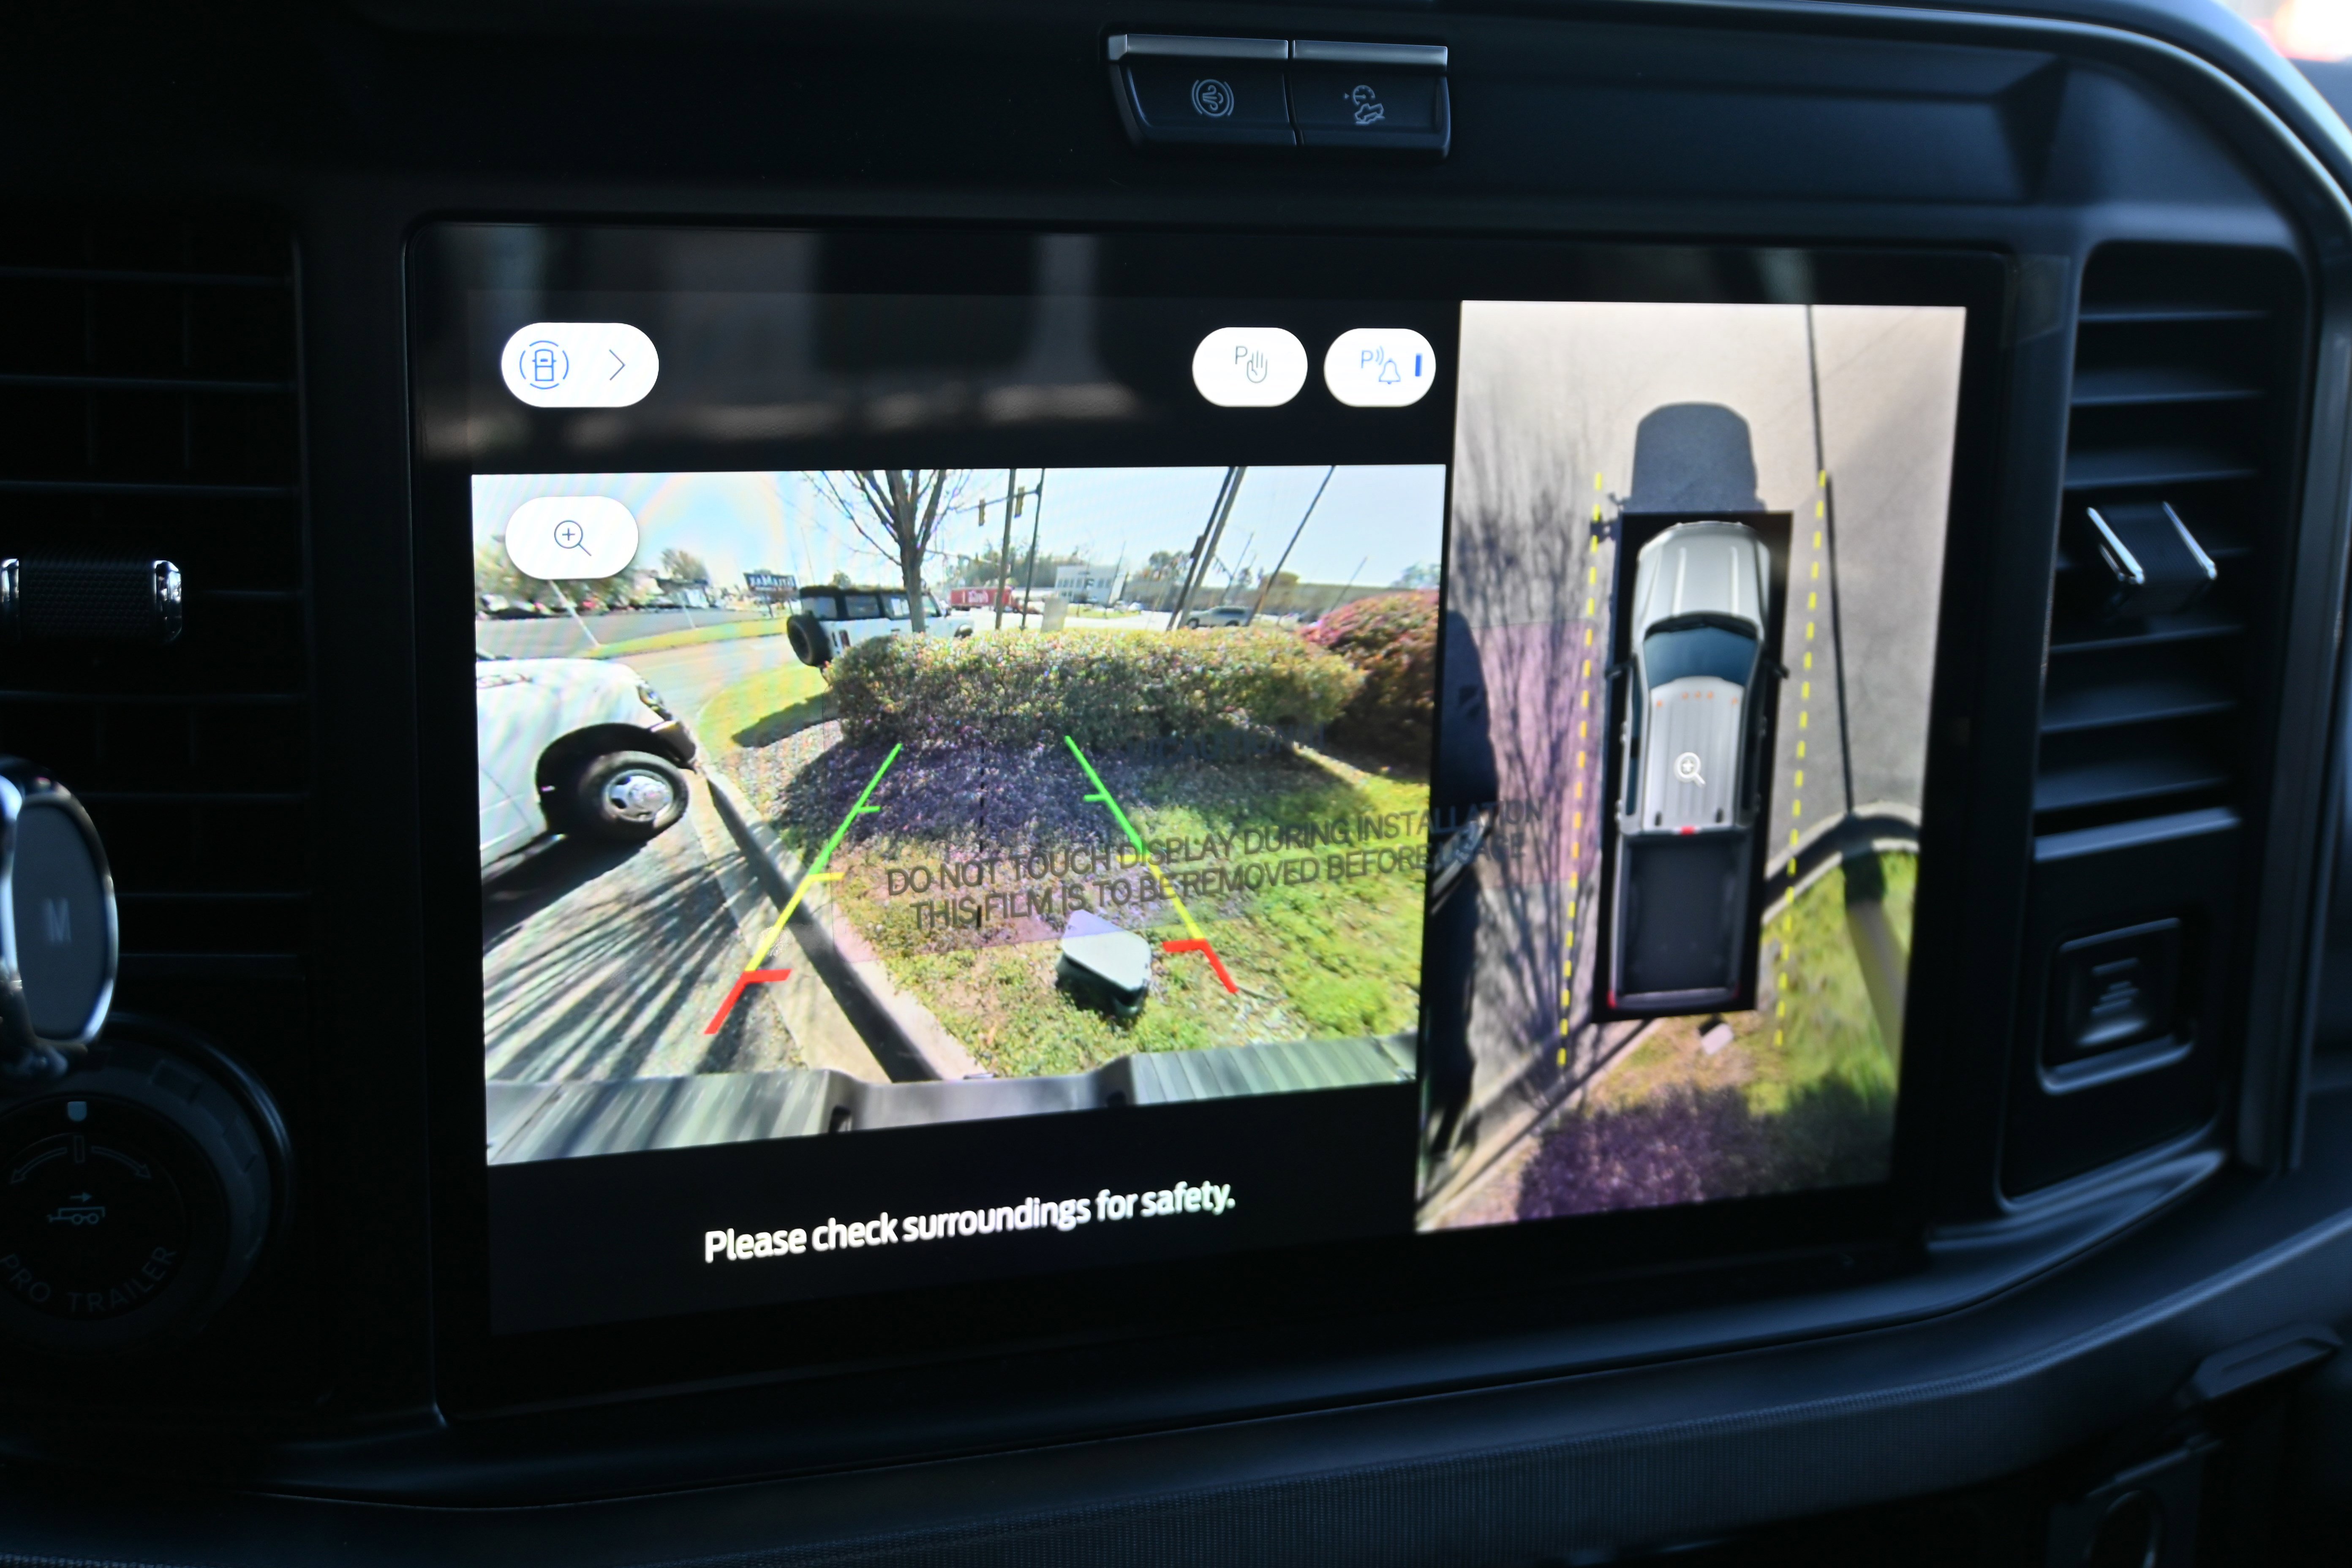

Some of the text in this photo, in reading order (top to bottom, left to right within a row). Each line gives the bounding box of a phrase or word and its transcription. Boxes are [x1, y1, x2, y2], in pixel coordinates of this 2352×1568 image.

[888, 797, 1543, 896] DO NOT TOUCH DISPLAY DURING INSTALLATION
[909, 895, 979, 929] THIS
[985, 887, 1054, 921] FILM
[1062, 882, 1086, 917] IS
[1092, 878, 1132, 907] TO
[1140, 872, 1178, 902] BE
[1183, 856, 1320, 897] REMOVED
[1327, 842, 1434, 880] BEFORE
[705, 1180, 1236, 1263] Please check surroundings for safety.
[0, 1246, 178, 1312] PRO TRAILER
